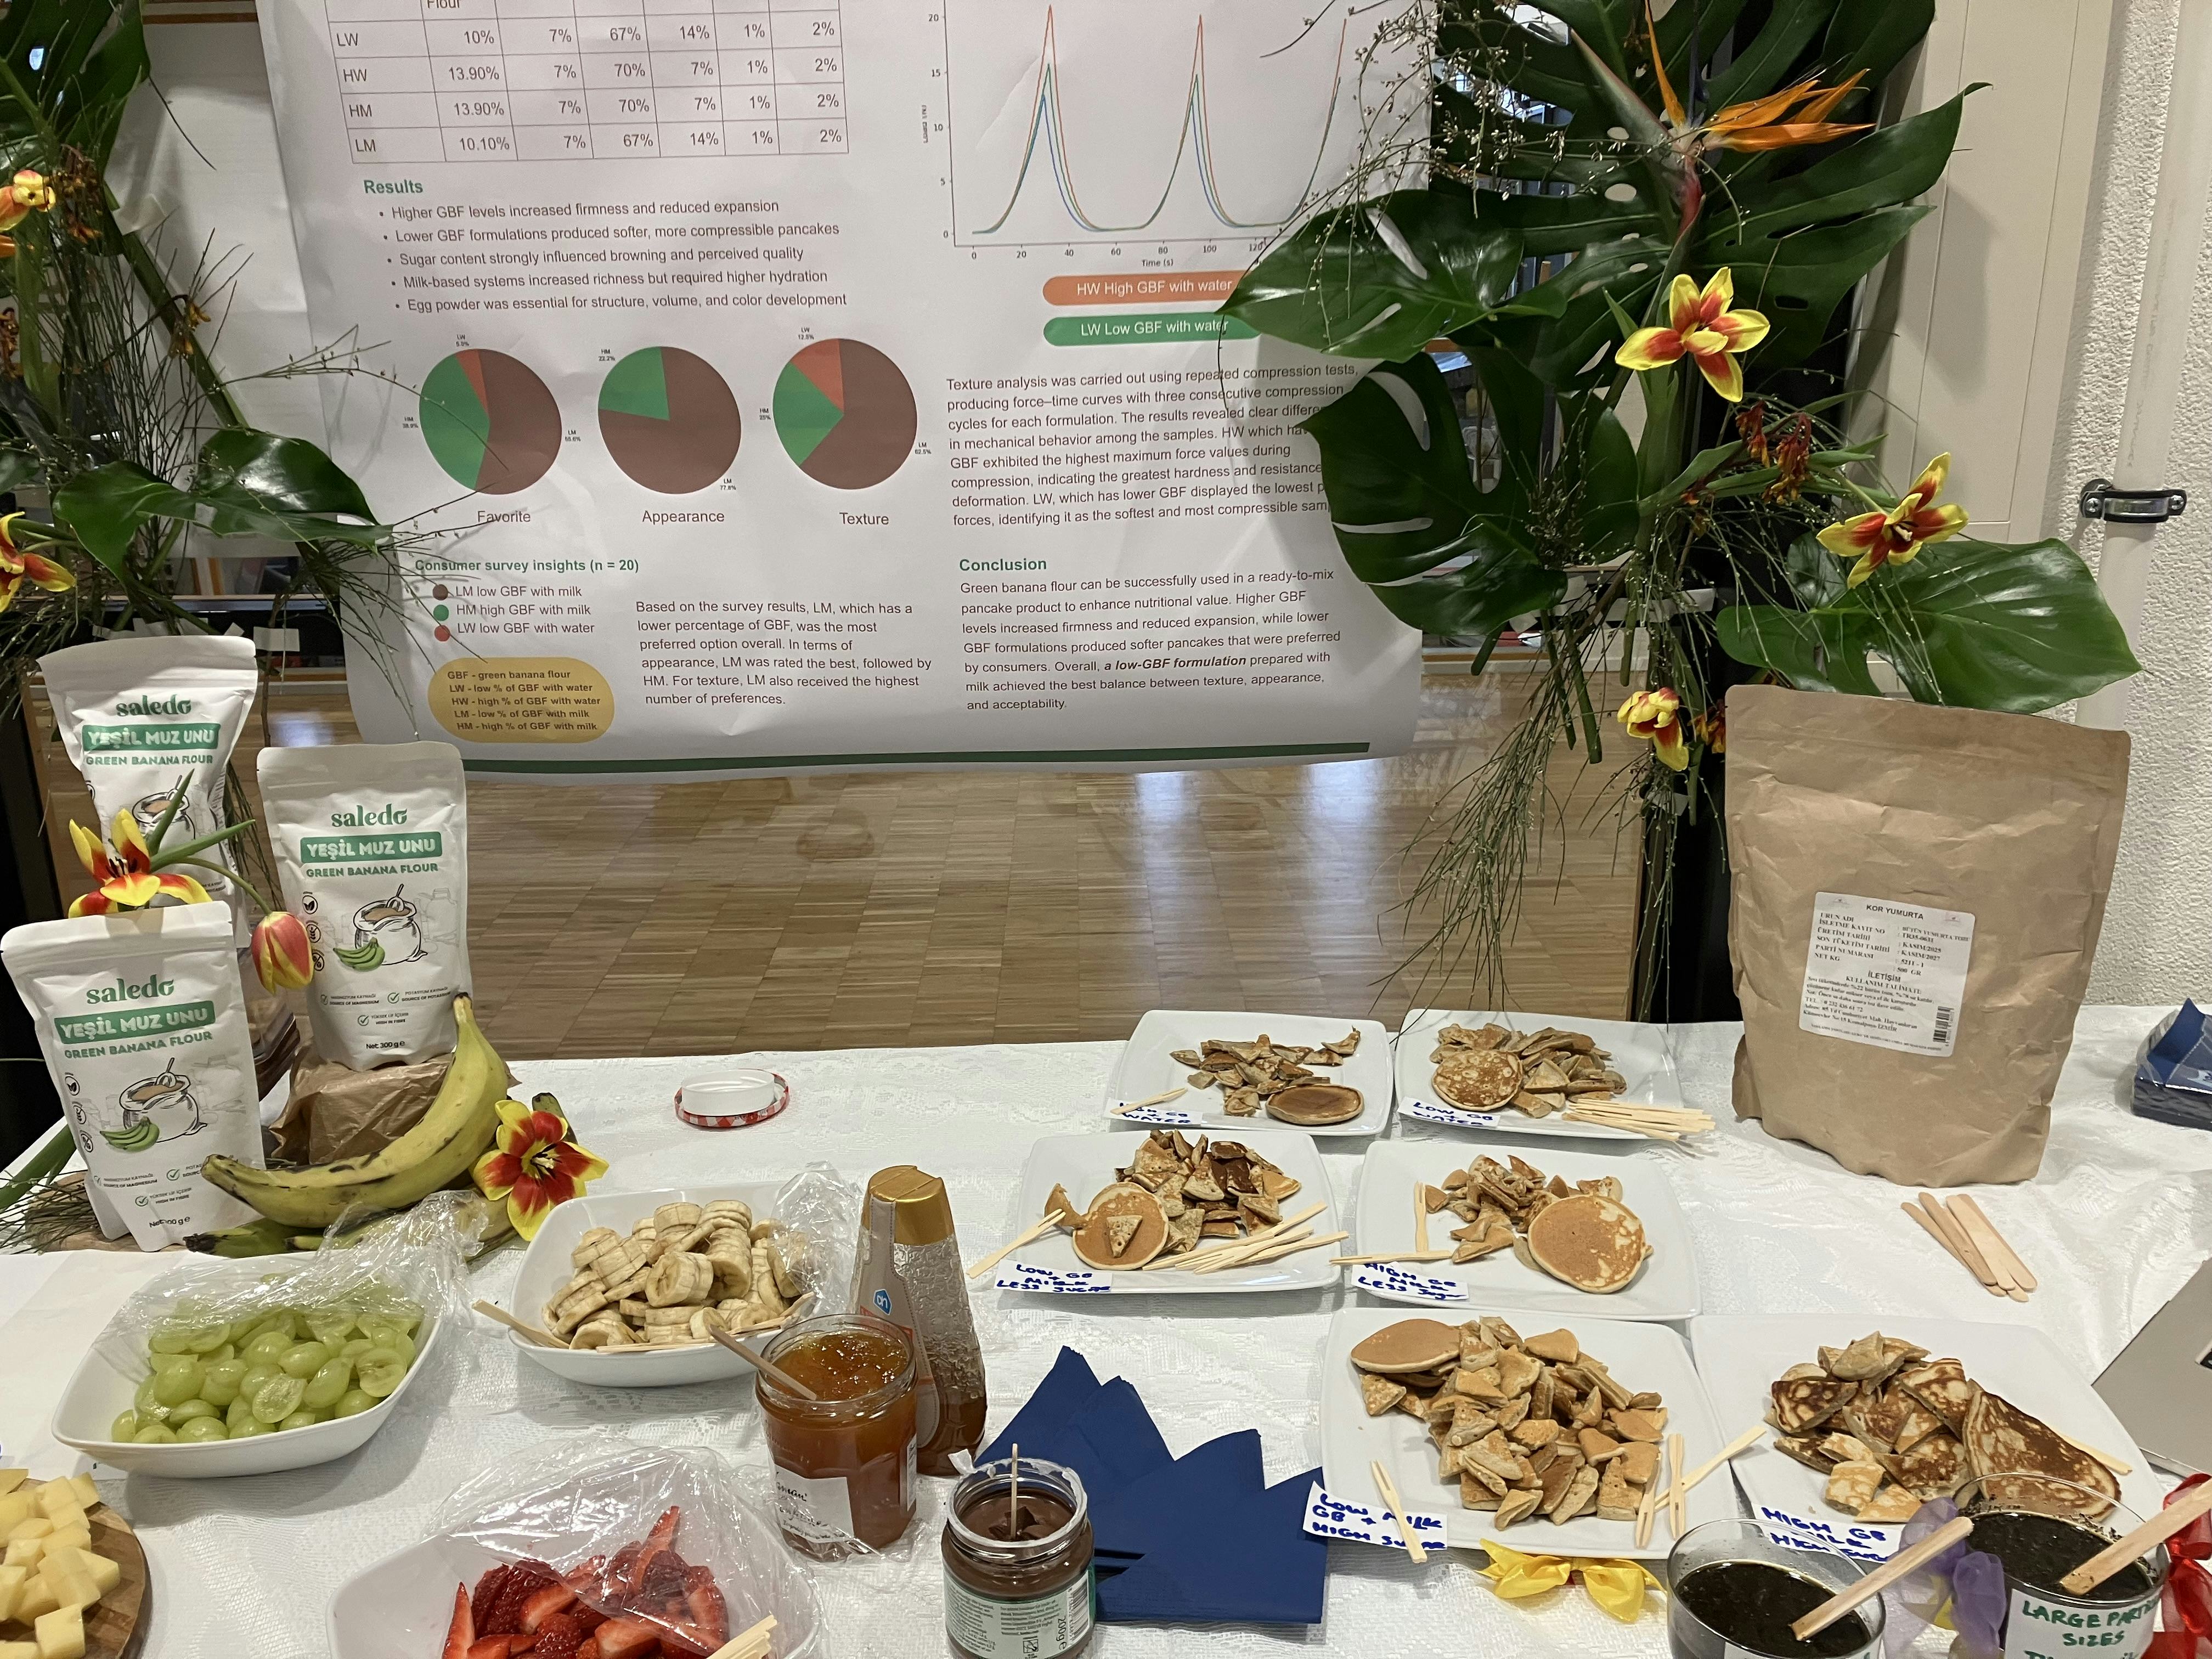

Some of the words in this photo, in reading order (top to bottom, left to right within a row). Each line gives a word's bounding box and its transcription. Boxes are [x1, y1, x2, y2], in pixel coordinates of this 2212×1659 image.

[337, 33, 358, 46] LW
[465, 30, 494, 44] 10%
[549, 29, 571, 42] 7%
[610, 26, 640, 41] 67%
[680, 25, 709, 40] 14%
[744, 24, 765, 37] 1%
[813, 21, 834, 35] 2%
[356, 139, 376, 151] LM
[460, 137, 509, 150] 10.10%
[563, 135, 585, 148] 7%
[624, 134, 653, 146] 67%
[691, 132, 718, 145] 14%
[753, 131, 772, 144] 1%
[820, 129, 841, 142] 2%
[364, 179, 423, 194] Results
[392, 207, 432, 221] Higher
[437, 206, 464, 218] GBF
[469, 205, 505, 217] levels
[510, 204, 571, 217] increased
[576, 203, 628, 215] firmness
[633, 202, 655, 214] and
[661, 201, 709, 213] reduced
[715, 200, 778, 215] expansion
[1077, 283, 1100, 295] HW
[1105, 282, 1132, 297] High
[1137, 281, 1165, 293] GBF
[1170, 280, 1193, 292] with
[1198, 280, 1232, 291] water
[1081, 324, 1101, 336] LW
[1105, 323, 1130, 335] Low
[1135, 321, 1161, 334] GBF
[1166, 320, 1190, 332] with
[1195, 320, 1228, 331] water
[946, 379, 992, 390] Texture
[997, 376, 1047, 390] analysis
[1052, 377, 1075, 386] was
[1081, 373, 1121, 385] carried
[1127, 373, 1145, 383] out
[1150, 371, 1181, 385] using
[1186, 368, 1239, 382] repeated
[1244, 365, 1321, 380] compression
[1326, 364, 1358, 376] tests,
[478, 511, 531, 523] Favorite
[642, 511, 724, 525] Appearance
[839, 512, 889, 524] Texture
[415, 560, 481, 571] Consumer
[486, 562, 528, 573] survey
[533, 560, 585, 573] insights
[590, 560, 602, 573] (n
[619, 560, 638, 573] 20)
[960, 558, 1046, 571] Conclusion
[961, 583, 997, 593] Green
[1002, 583, 1046, 592] banana
[1051, 581, 1077, 591] flour
[1081, 582, 1101, 590] can
[1106, 578, 1120, 588] be
[1125, 575, 1197, 588] successfully
[1201, 573, 1229, 584] used
[1234, 573, 1243, 583] in
[1260, 568, 1334, 583] ready-to-mix
[456, 586, 472, 596] LM
[477, 586, 496, 596] low
[501, 586, 527, 596] GBF
[531, 586, 554, 596] with
[559, 586, 582, 596] milk
[636, 601, 675, 612] Based
[699, 601, 718, 611] the
[723, 603, 763, 614] survey
[768, 602, 809, 614] results,
[814, 602, 835, 614] LM,
[839, 603, 874, 613] which
[879, 603, 900, 613] has
[116, 694, 191, 717] saledo
[145, 730, 180, 745] MUZ
[184, 729, 215, 744] UNU
[86, 756, 128, 765] GREEN
[132, 755, 179, 765] BANANA
[182, 755, 213, 765] FLOUR
[331, 803, 408, 827] saledo
[306, 839, 356, 860] YEŞİL
[359, 840, 396, 856] MUZ
[399, 838, 436, 854] UNU
[306, 866, 345, 878] GREEN
[347, 865, 398, 876] BANANA
[400, 862, 439, 874] FLOUR
[1866, 904, 1884, 913] KOR
[1886, 907, 1924, 920] YUMURTA
[86, 974, 174, 1004] saledo
[60, 1017, 117, 1040] YEŞİL
[120, 1014, 162, 1033] MUZ
[166, 1008, 208, 1026] UNU
[64, 1047, 106, 1059] GREEN
[109, 1039, 167, 1056] BANANA
[170, 1031, 213, 1046] FLOUR
[1413, 1102, 1454, 1114] LOW
[1016, 1263, 1053, 1276] LOW
[1320, 1493, 1368, 1515] LOW
[1312, 1505, 1345, 1522] GB
[1761, 1507, 1832, 1533] HIGH
[2022, 1600, 2101, 1629] LARGE
[2062, 1629, 2126, 1647] SIZES
